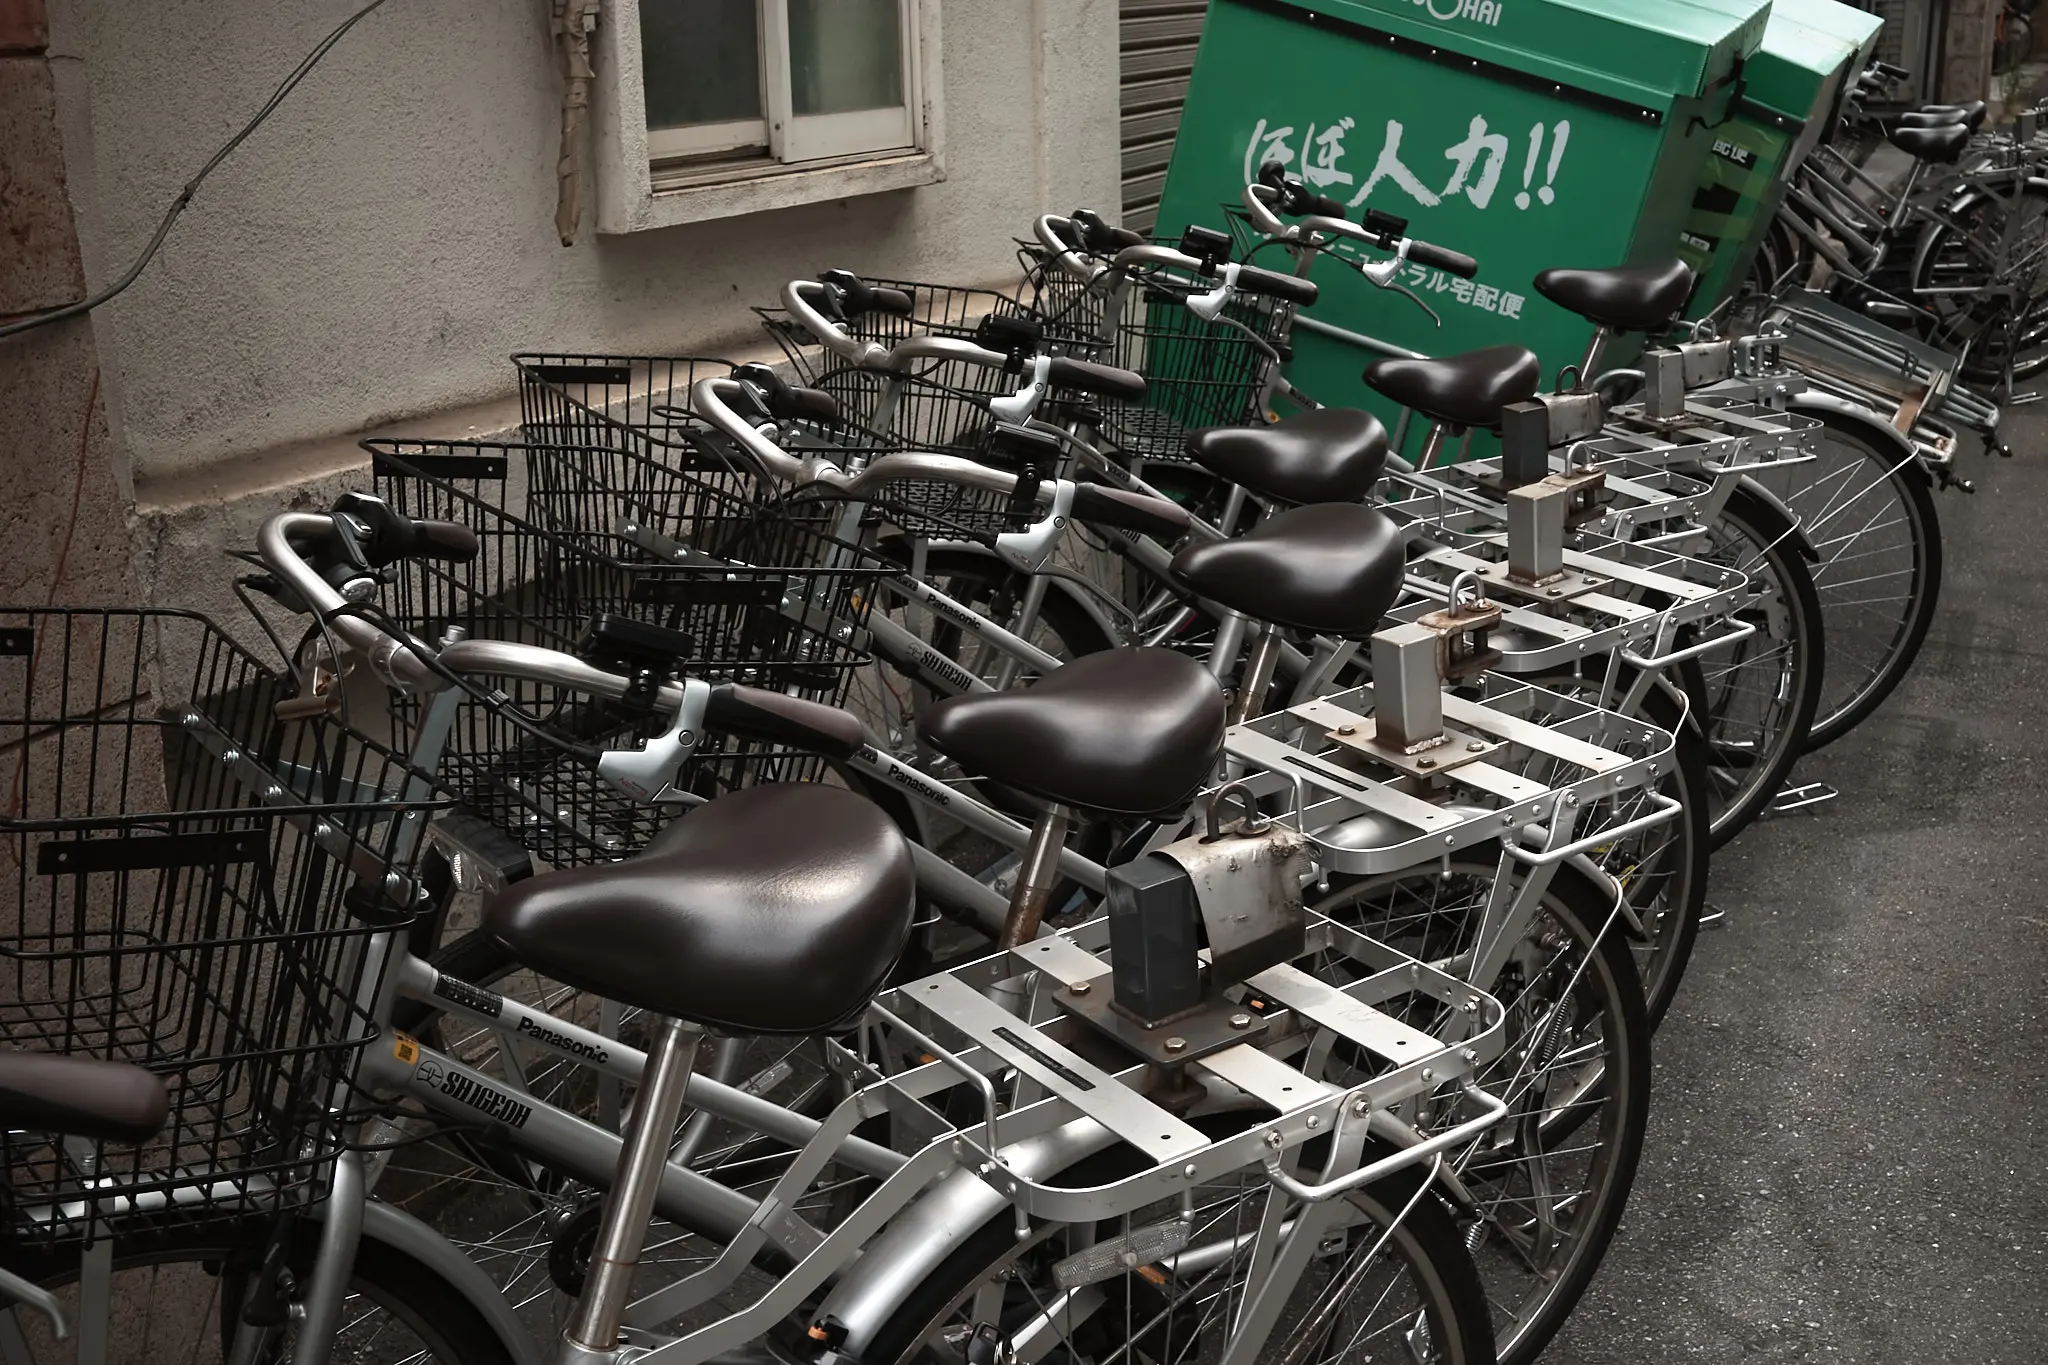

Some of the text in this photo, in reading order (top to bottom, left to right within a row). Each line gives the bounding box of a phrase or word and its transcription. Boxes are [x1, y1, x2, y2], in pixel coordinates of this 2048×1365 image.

[927, 593, 981, 630] Panasonic
[920, 651, 972, 691] SHIGEOH
[888, 763, 950, 806] Panasonic
[516, 1016, 609, 1064] Panasonic
[440, 1071, 533, 1130] SHIGEOH
